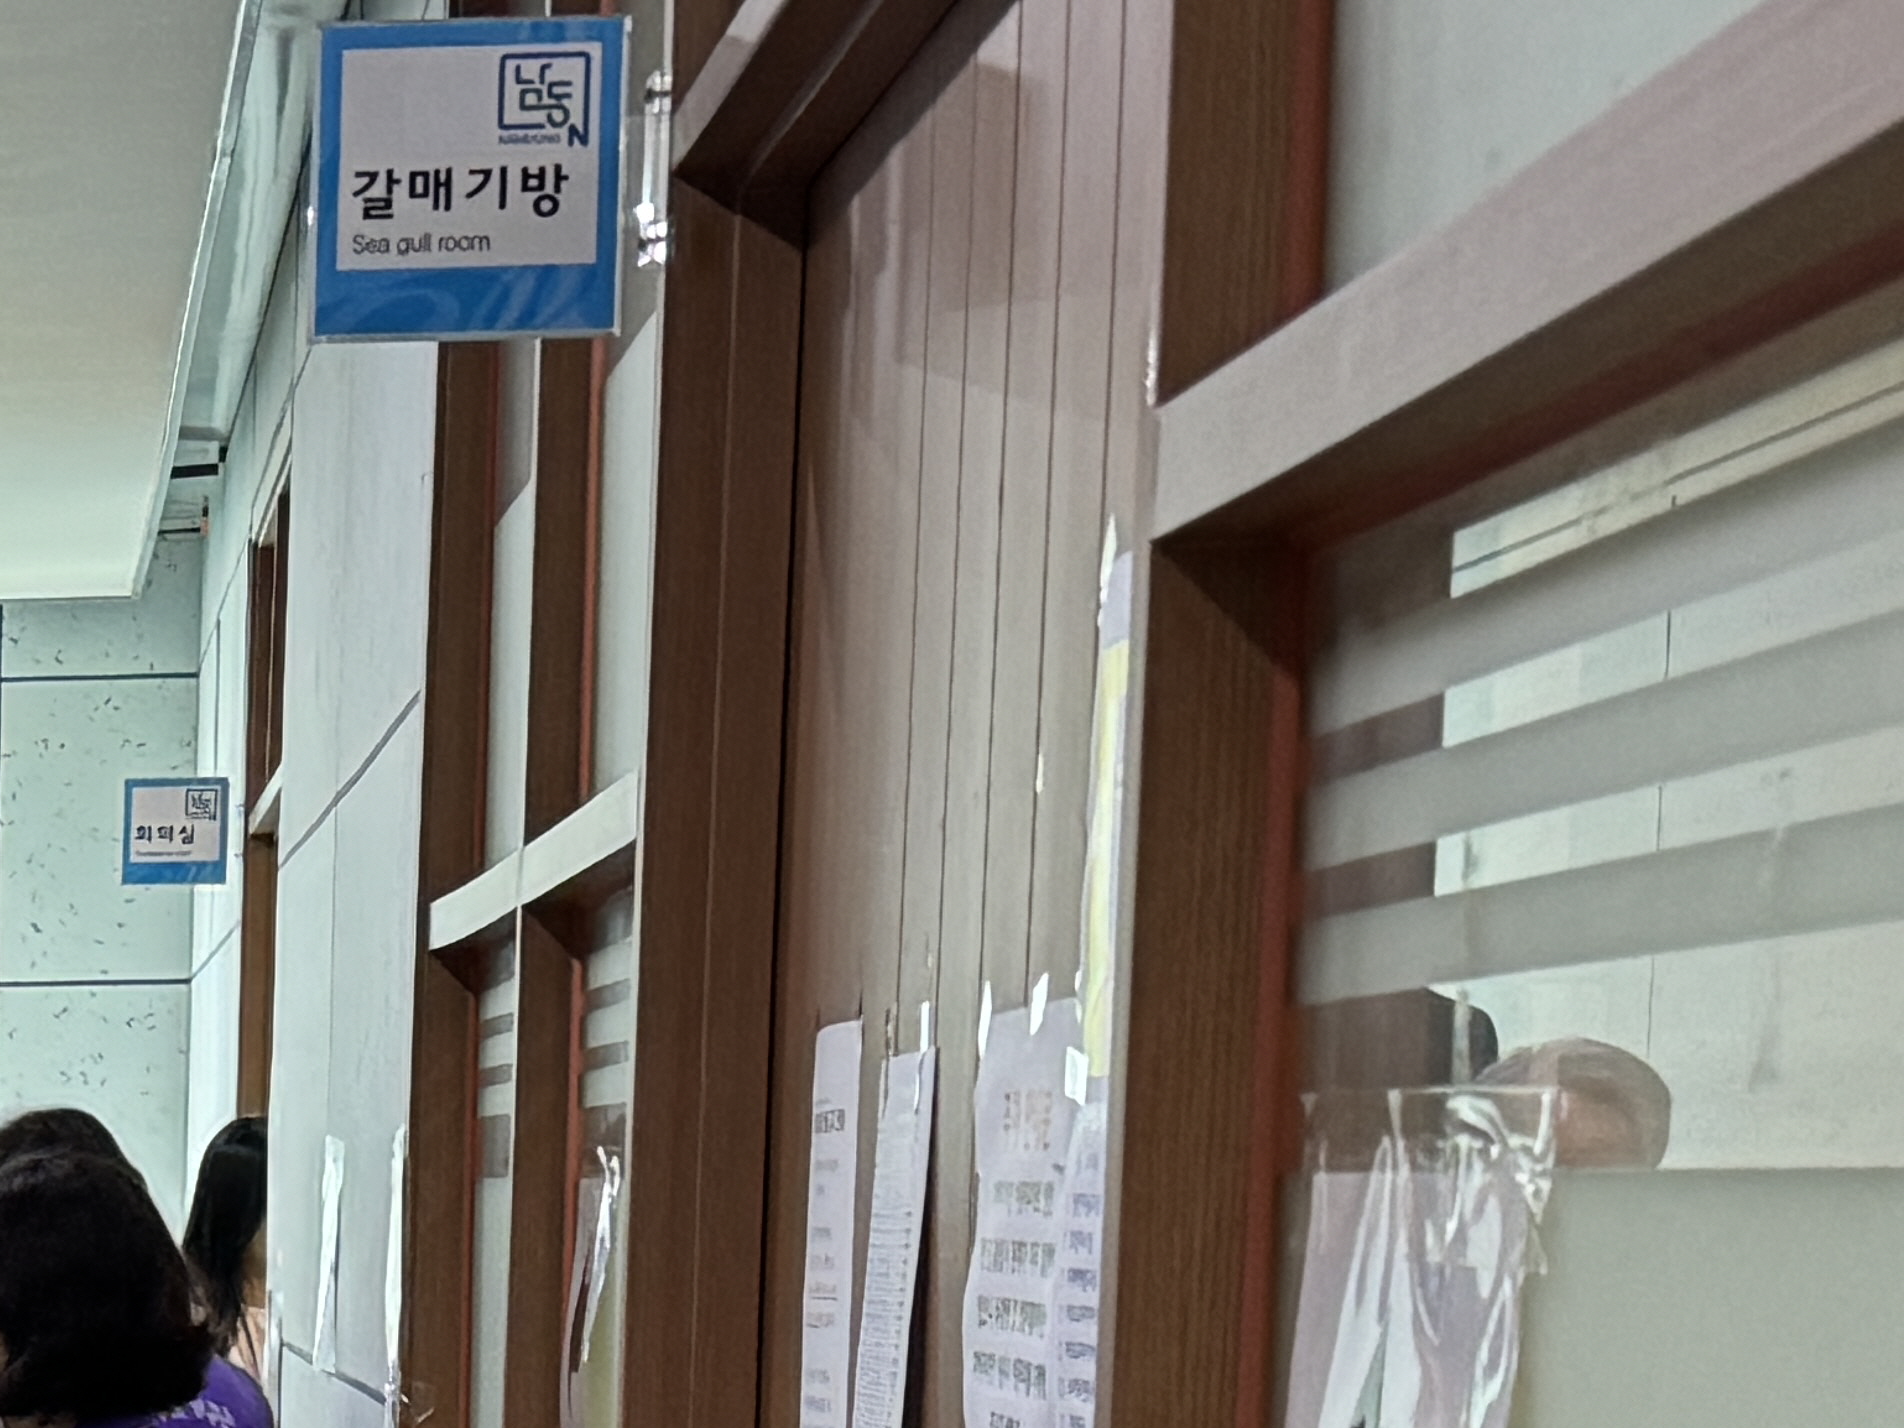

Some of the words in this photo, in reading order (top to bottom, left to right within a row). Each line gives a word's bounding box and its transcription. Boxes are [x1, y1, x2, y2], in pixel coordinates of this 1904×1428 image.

[351, 164, 569, 220] 갈매기방
[353, 234, 390, 255] Sea
[396, 233, 432, 256] gull
[438, 234, 491, 254] room
